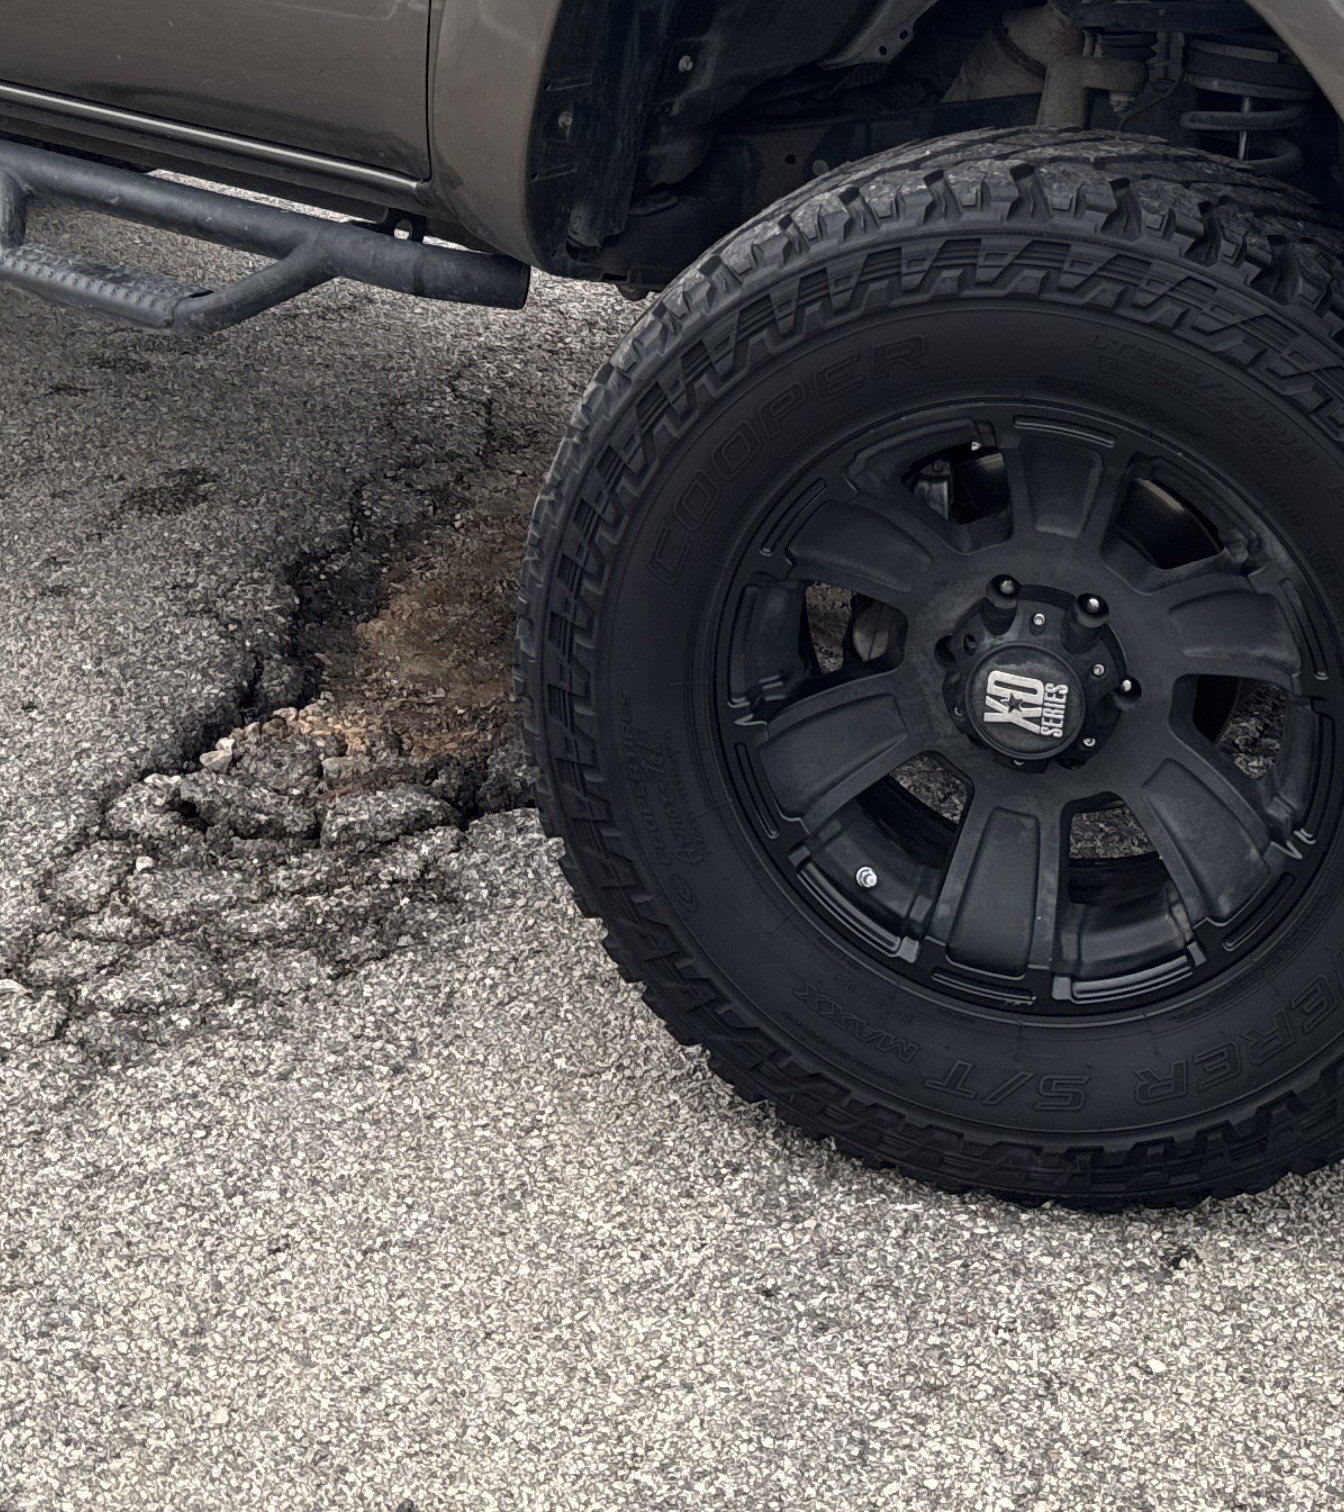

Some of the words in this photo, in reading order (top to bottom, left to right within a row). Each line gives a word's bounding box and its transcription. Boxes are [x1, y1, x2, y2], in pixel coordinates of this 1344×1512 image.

[649, 334, 928, 584] COOPER
[983, 670, 1044, 734] XD
[1040, 682, 1068, 738] SERIES
[793, 982, 919, 1064] MAXX
[925, 1060, 1090, 1113] S/T
